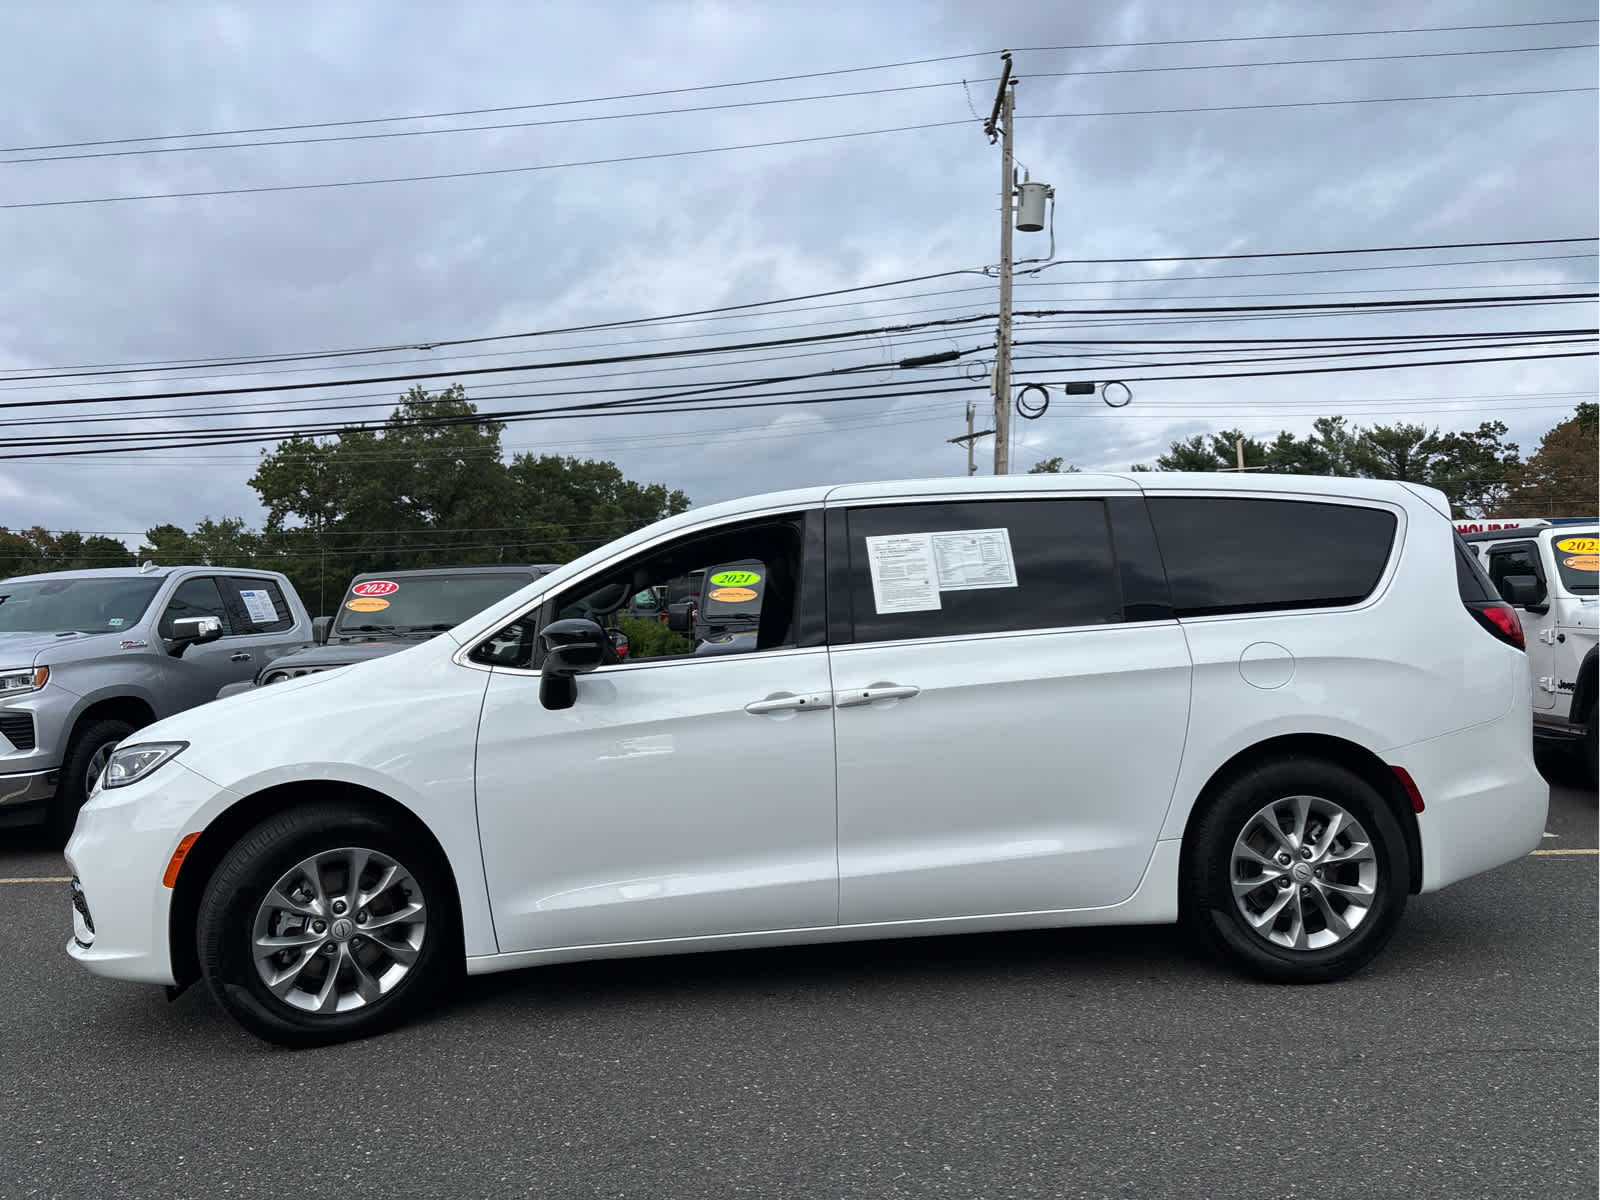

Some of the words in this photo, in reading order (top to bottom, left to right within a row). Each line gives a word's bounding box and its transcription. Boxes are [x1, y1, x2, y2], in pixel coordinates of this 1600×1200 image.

[1567, 541, 1599, 551] 202
[719, 574, 752, 584] 2021
[360, 583, 393, 594] 2023
